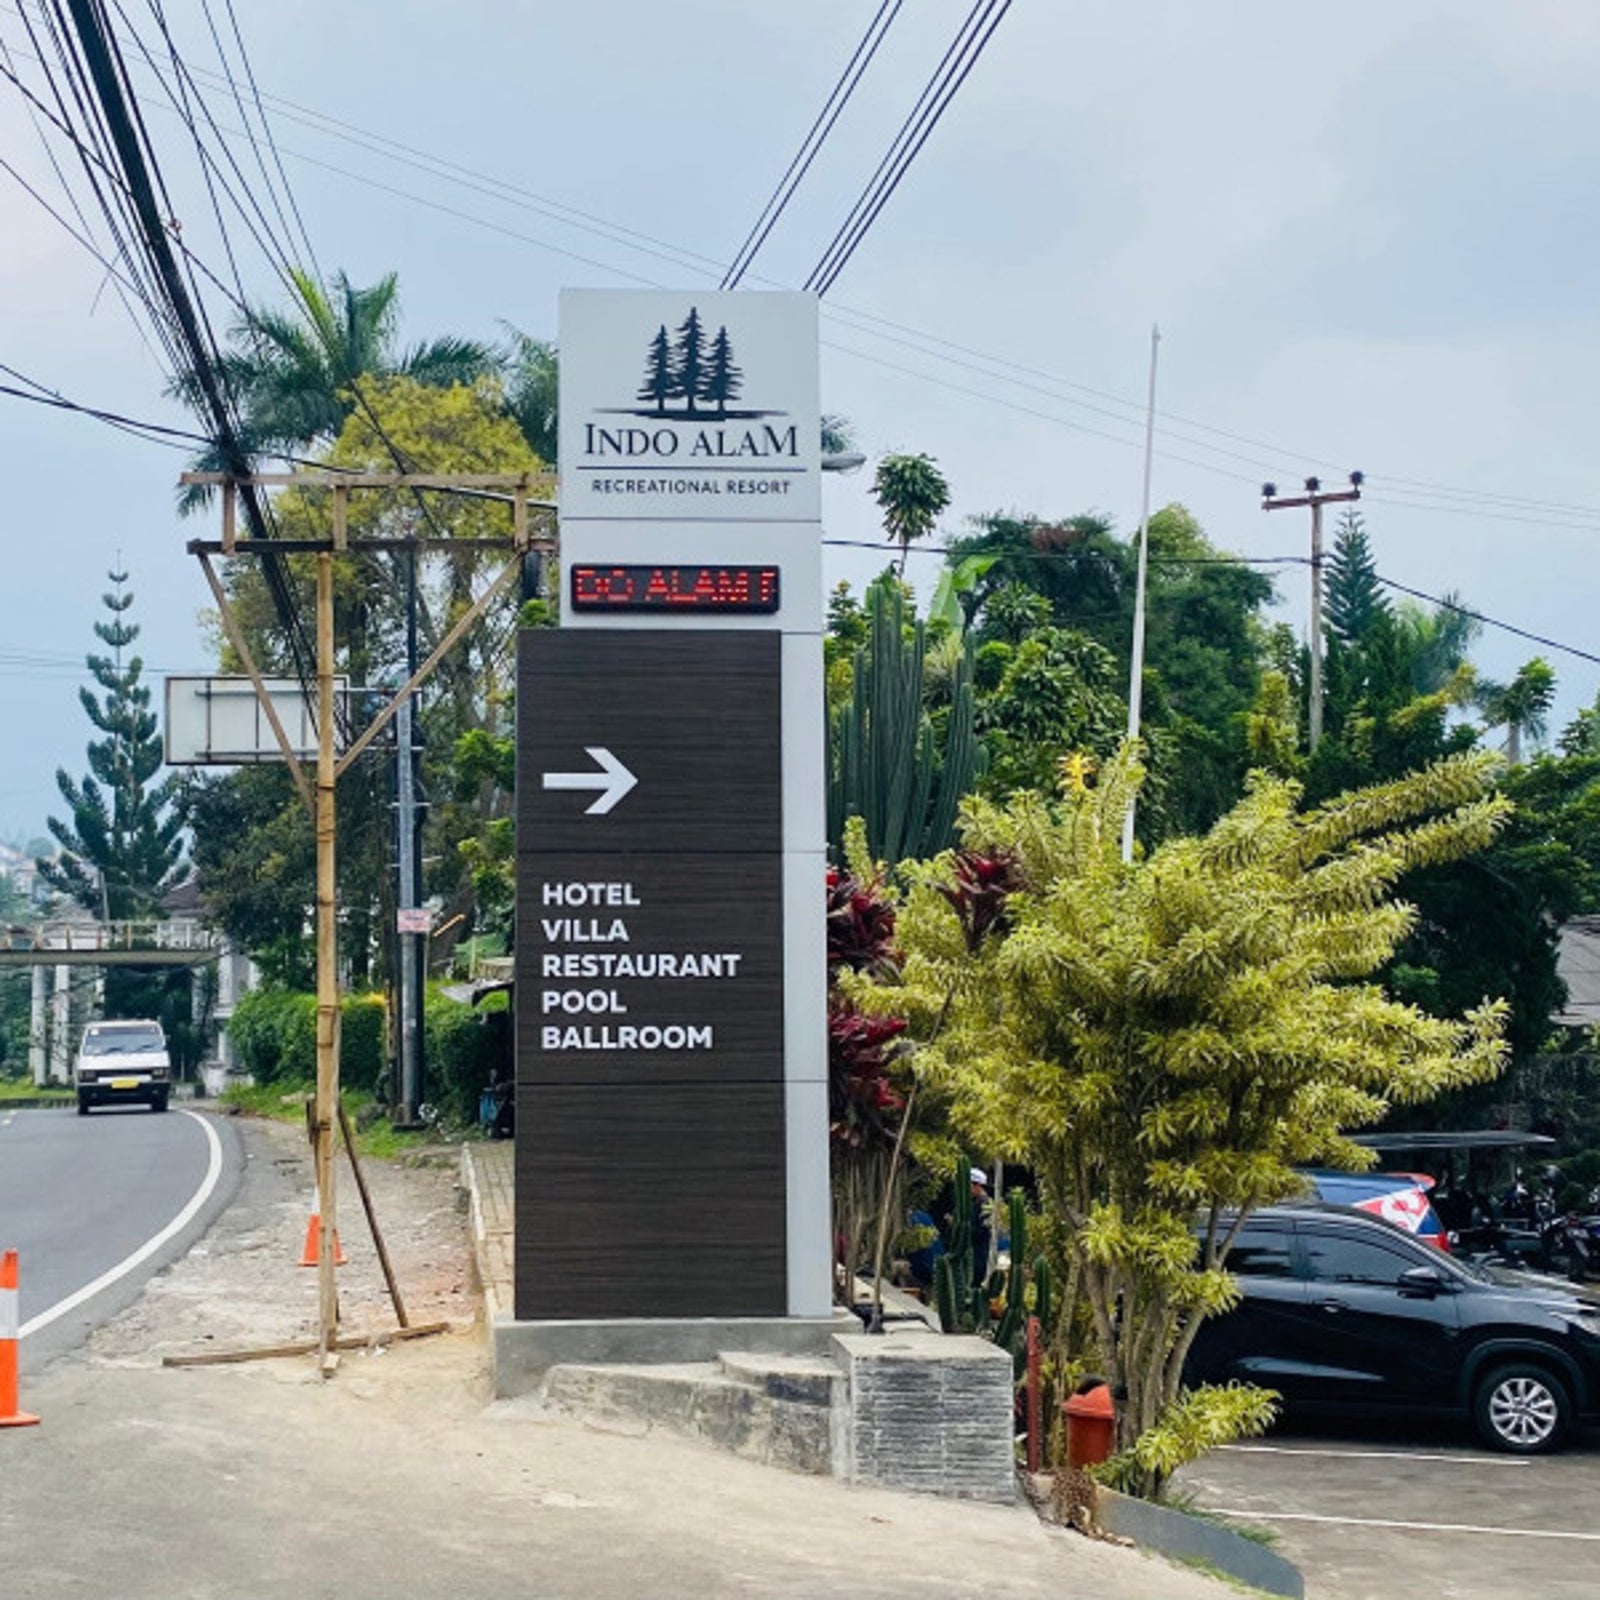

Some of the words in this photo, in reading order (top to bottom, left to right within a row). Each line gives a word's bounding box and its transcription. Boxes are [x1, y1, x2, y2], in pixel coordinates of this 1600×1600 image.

[584, 422, 679, 457] INDO
[690, 424, 799, 457] ALAM
[592, 479, 721, 495] RECREATIONAL
[726, 479, 790, 495] RESORT
[542, 882, 641, 906] HOTEL
[541, 918, 630, 942] VILLA
[542, 953, 742, 977] RESTAURANT
[542, 989, 628, 1014] POOL
[541, 1025, 713, 1049] BALLROOM
